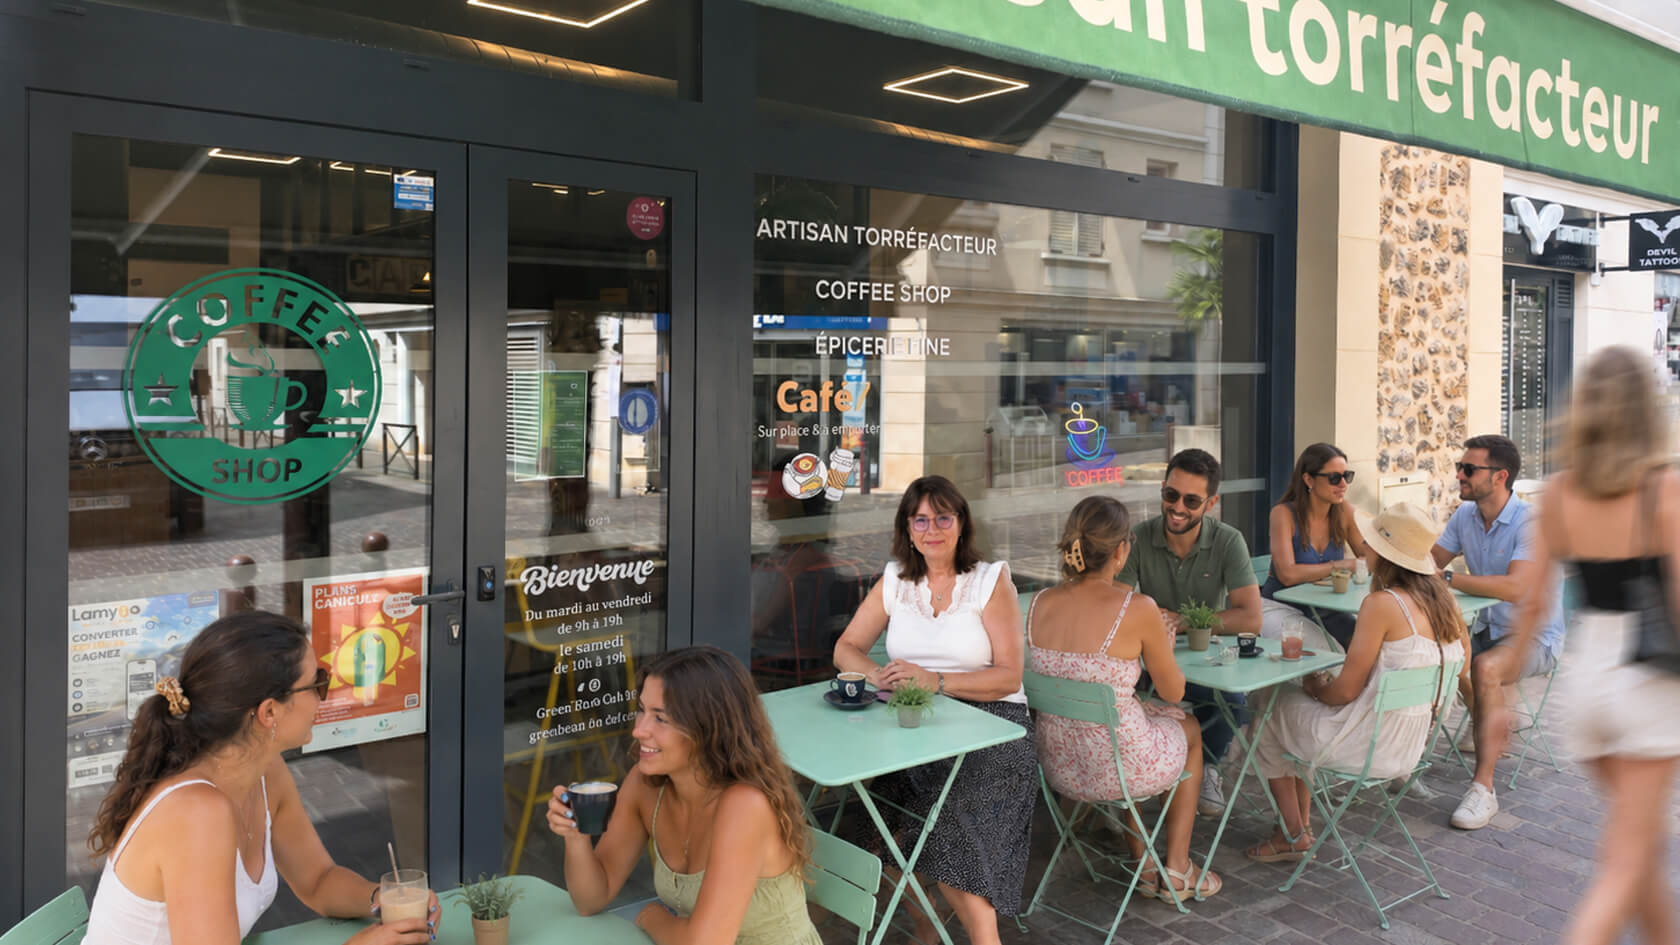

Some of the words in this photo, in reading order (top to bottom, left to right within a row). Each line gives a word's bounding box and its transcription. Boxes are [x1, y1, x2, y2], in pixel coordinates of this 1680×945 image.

[1239, 0, 1660, 165] torréfacteur
[756, 218, 848, 244] ARTISAN
[853, 226, 997, 256] TORRÉFACTEUR
[1639, 256, 1680, 267] TATTOO
[1647, 247, 1678, 256] DEVIL
[815, 279, 895, 302] COFFEE
[899, 284, 952, 304] SHOP
[167, 284, 352, 355] COFFEE
[757, 425, 778, 438] Sur
[780, 424, 810, 439] place
[211, 457, 302, 484] SHOP
[1064, 466, 1125, 487] COFFEE
[519, 559, 655, 596] Bienvenue
[315, 584, 357, 599] PLANS
[525, 609, 543, 622] Du
[546, 601, 582, 618] mardi
[585, 602, 600, 613] au
[602, 592, 652, 609] vendredi
[557, 622, 572, 635] de
[575, 619, 590, 632] 9h
[592, 617, 601, 630] à
[603, 614, 623, 627] 19h
[560, 644, 572, 657] le
[576, 635, 624, 655] samedi
[554, 661, 568, 675] de
[572, 657, 592, 671] 10h
[595, 655, 603, 667] à
[605, 651, 627, 665] 19h
[536, 704, 572, 719] Green
